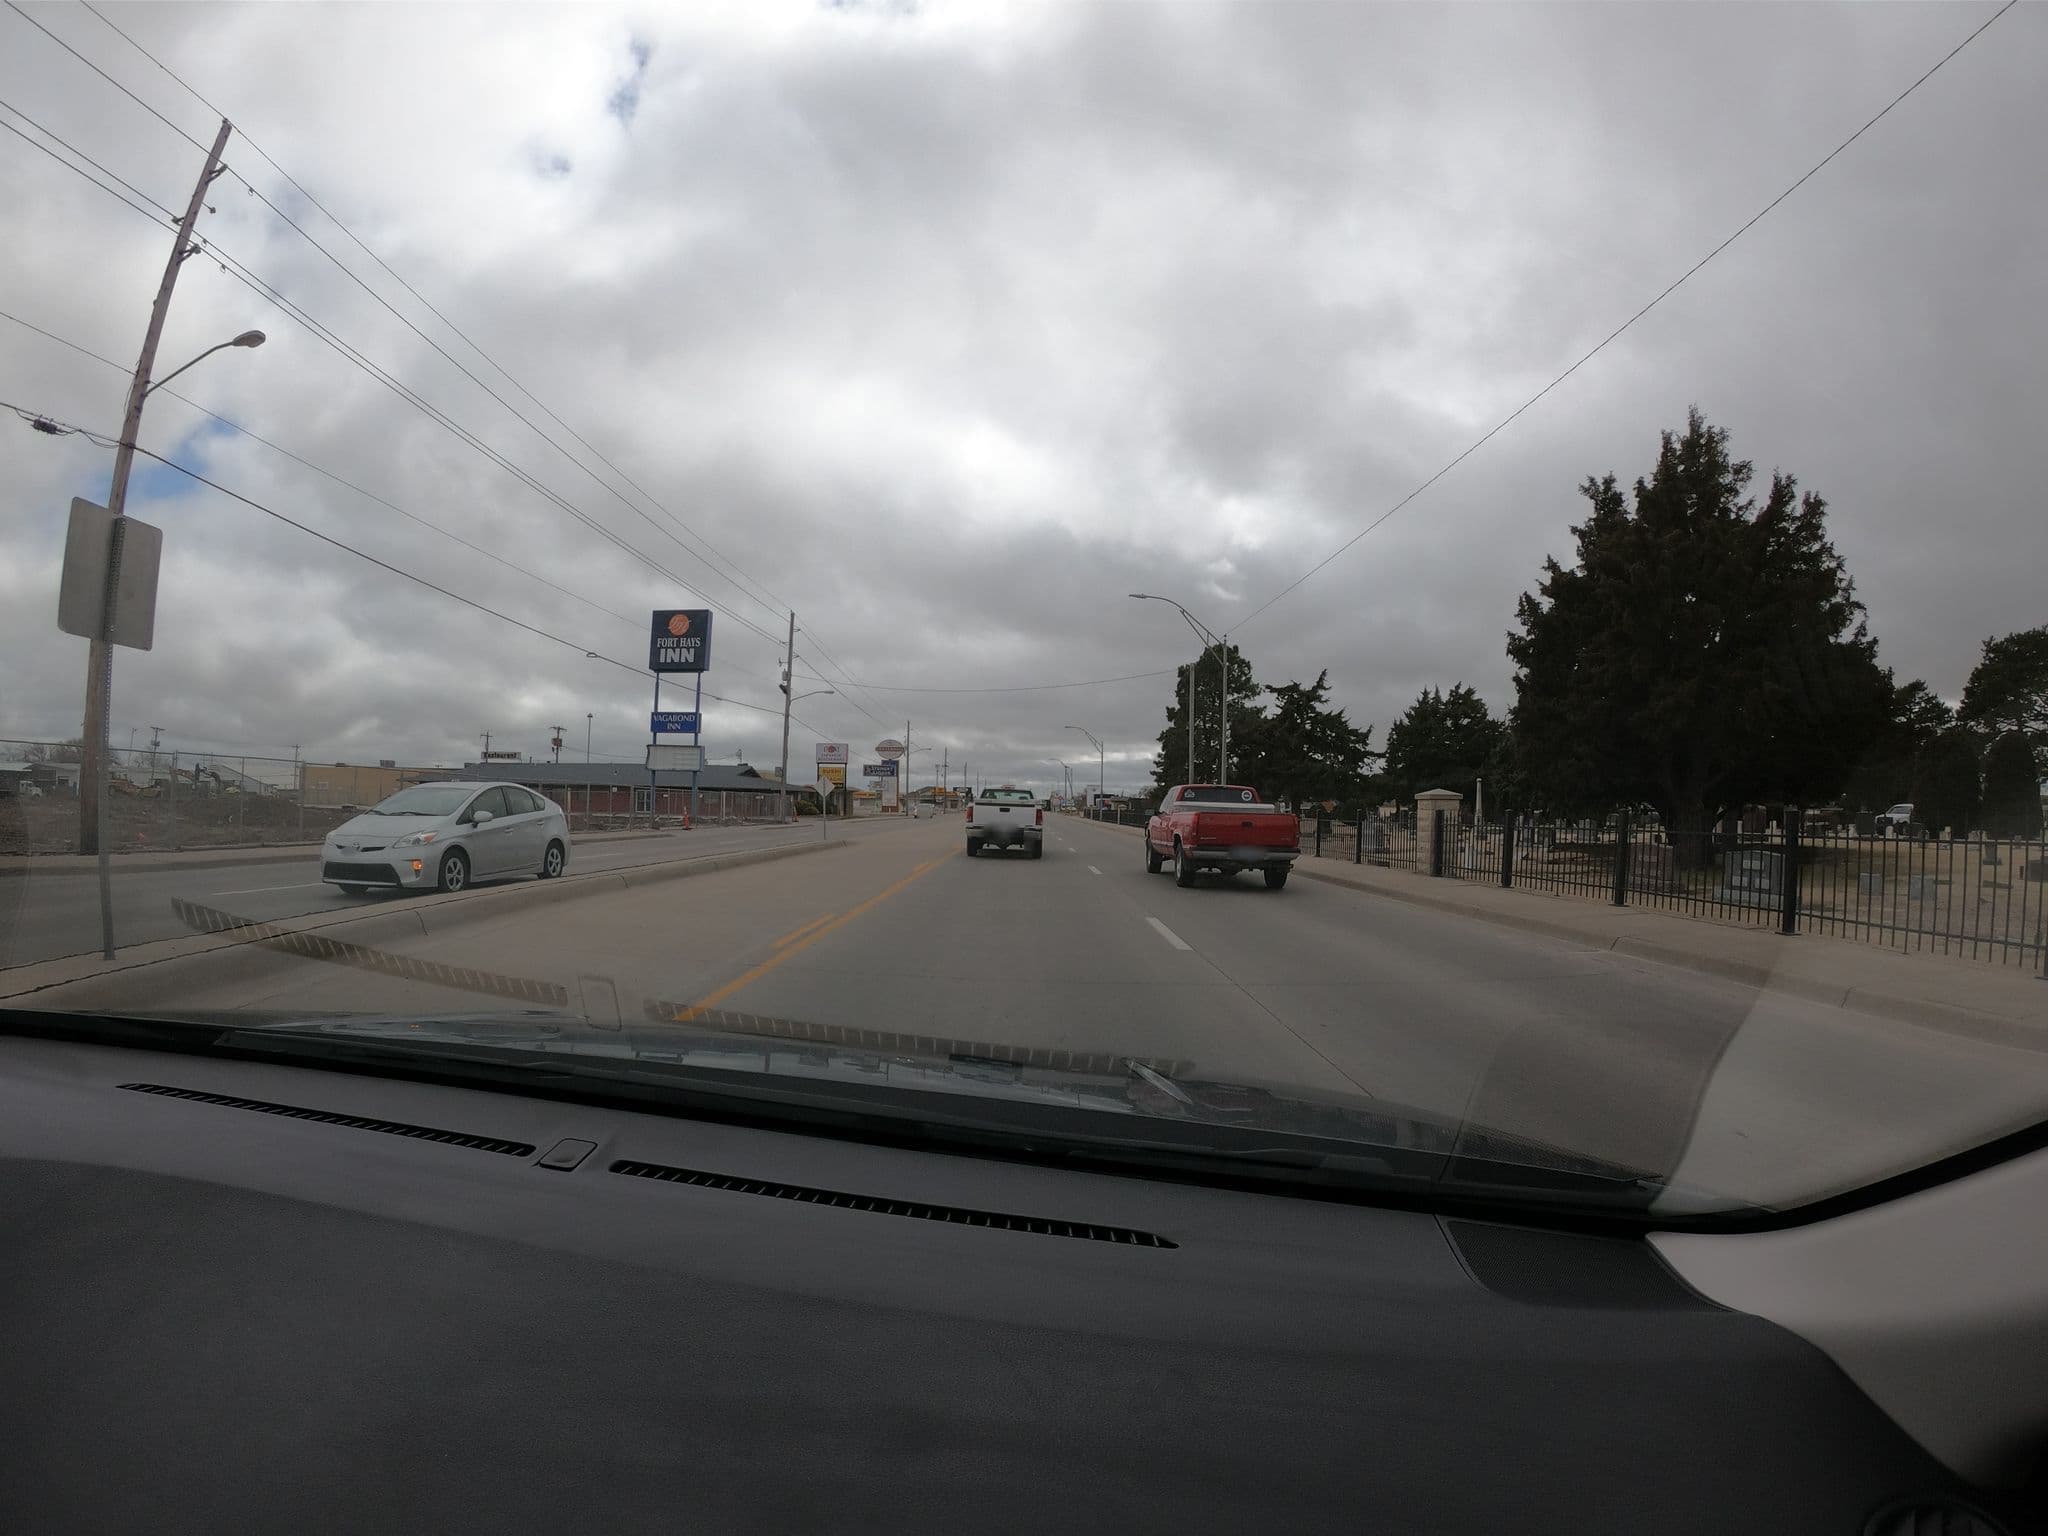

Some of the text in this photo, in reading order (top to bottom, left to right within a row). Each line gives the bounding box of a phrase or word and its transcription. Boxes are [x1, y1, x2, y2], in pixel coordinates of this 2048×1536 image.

[657, 637, 701, 647] FORT HAYS
[659, 648, 695, 663] INN
[653, 714, 695, 722] VAGABOND
